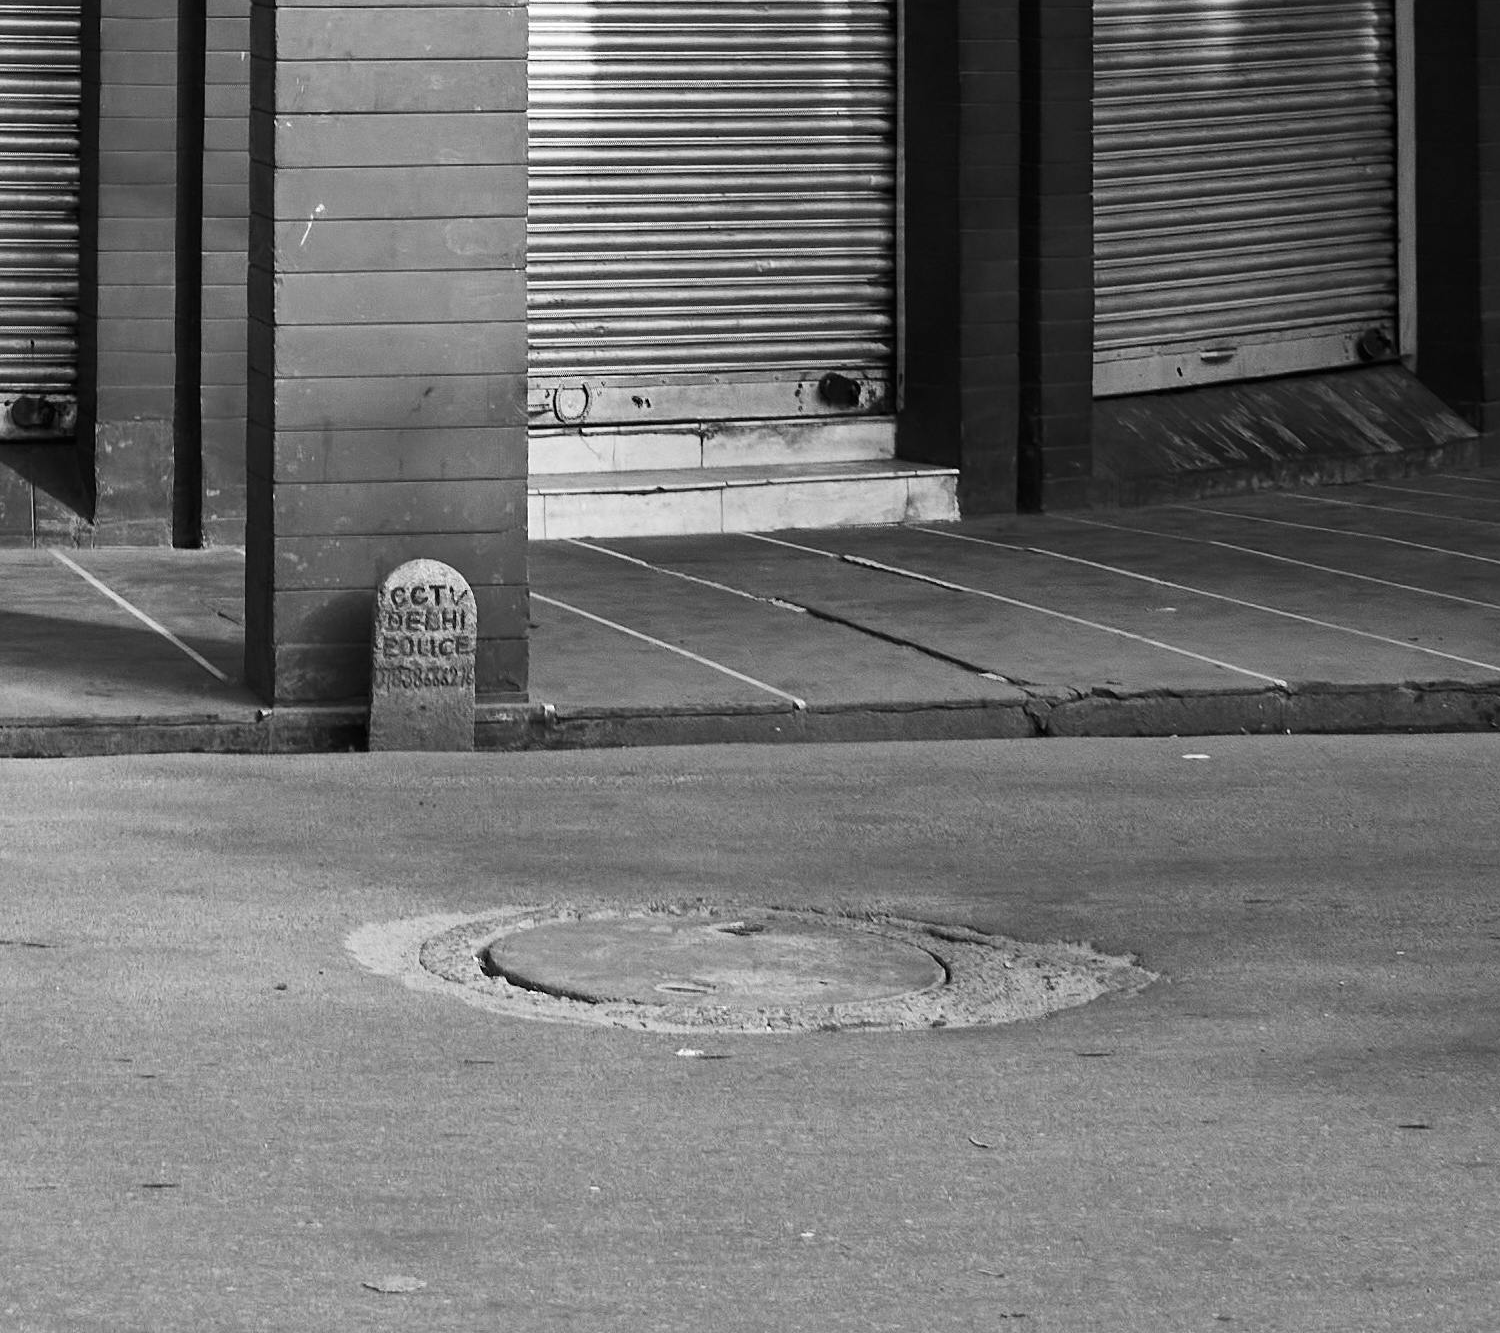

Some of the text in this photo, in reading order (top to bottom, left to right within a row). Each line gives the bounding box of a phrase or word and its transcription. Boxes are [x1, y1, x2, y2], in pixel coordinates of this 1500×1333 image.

[390, 584, 468, 608] CCTV
[385, 606, 465, 632] DELHI
[382, 636, 473, 658] POLICE
